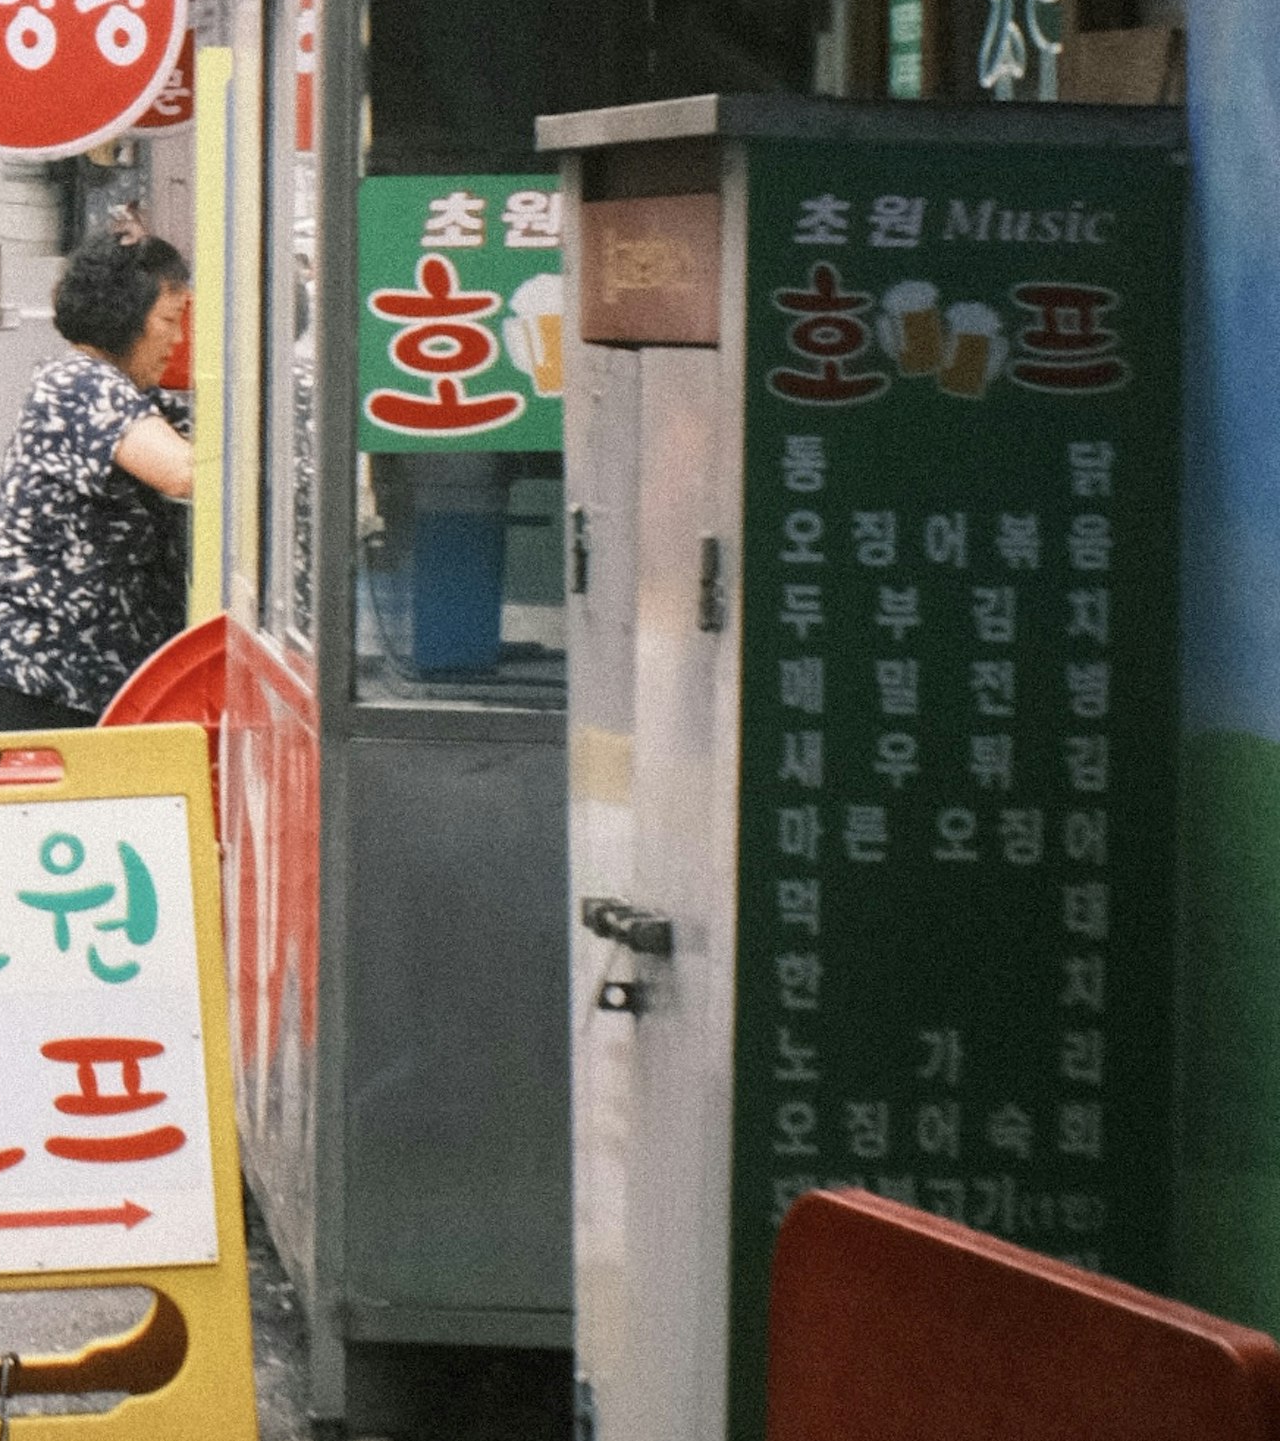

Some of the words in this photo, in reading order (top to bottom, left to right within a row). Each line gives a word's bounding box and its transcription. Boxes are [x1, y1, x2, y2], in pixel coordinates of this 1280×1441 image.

[794, 193, 927, 248] 초원
[942, 200, 1116, 244] Music
[364, 253, 525, 437] 호
